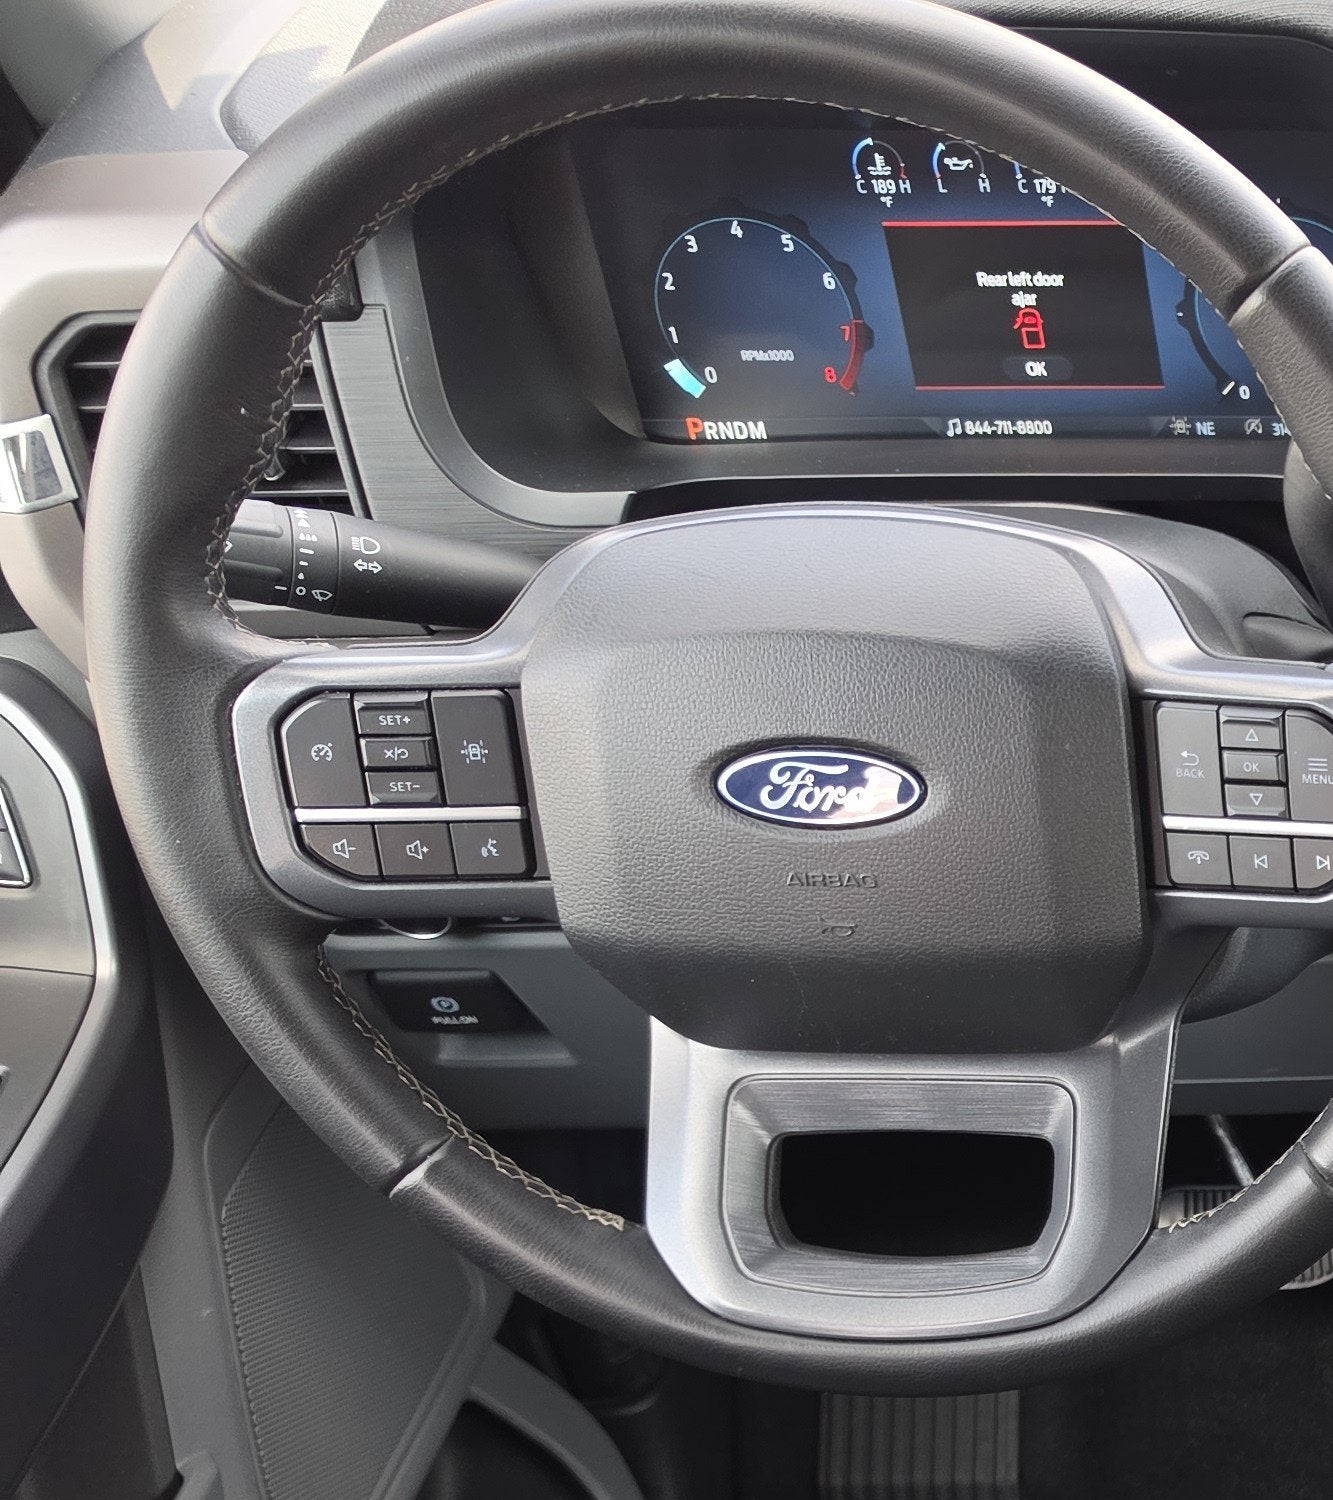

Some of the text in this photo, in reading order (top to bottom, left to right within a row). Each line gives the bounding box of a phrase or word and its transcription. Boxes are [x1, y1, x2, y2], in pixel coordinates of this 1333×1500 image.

[856, 179, 912, 194] C 189 H
[937, 178, 991, 193] L H
[1017, 179, 1028, 194] C
[730, 220, 743, 238] 4
[685, 234, 698, 252] 3
[781, 233, 794, 252] 5
[661, 272, 675, 291] 2
[822, 272, 836, 290] 6
[975, 270, 1065, 287] Rear left door
[1011, 290, 1037, 308] ajar
[668, 326, 678, 344] 1
[839, 325, 851, 343] 7
[704, 366, 718, 384] 0
[824, 366, 837, 383] 8
[1024, 361, 1047, 377] OK
[1238, 384, 1250, 400] 0
[964, 419, 1053, 436] 844-711-8800
[1195, 421, 1216, 436] NE
[1175, 767, 1206, 779] BACK
[1243, 761, 1260, 773] OK
[786, 871, 879, 889] AIRBAG
